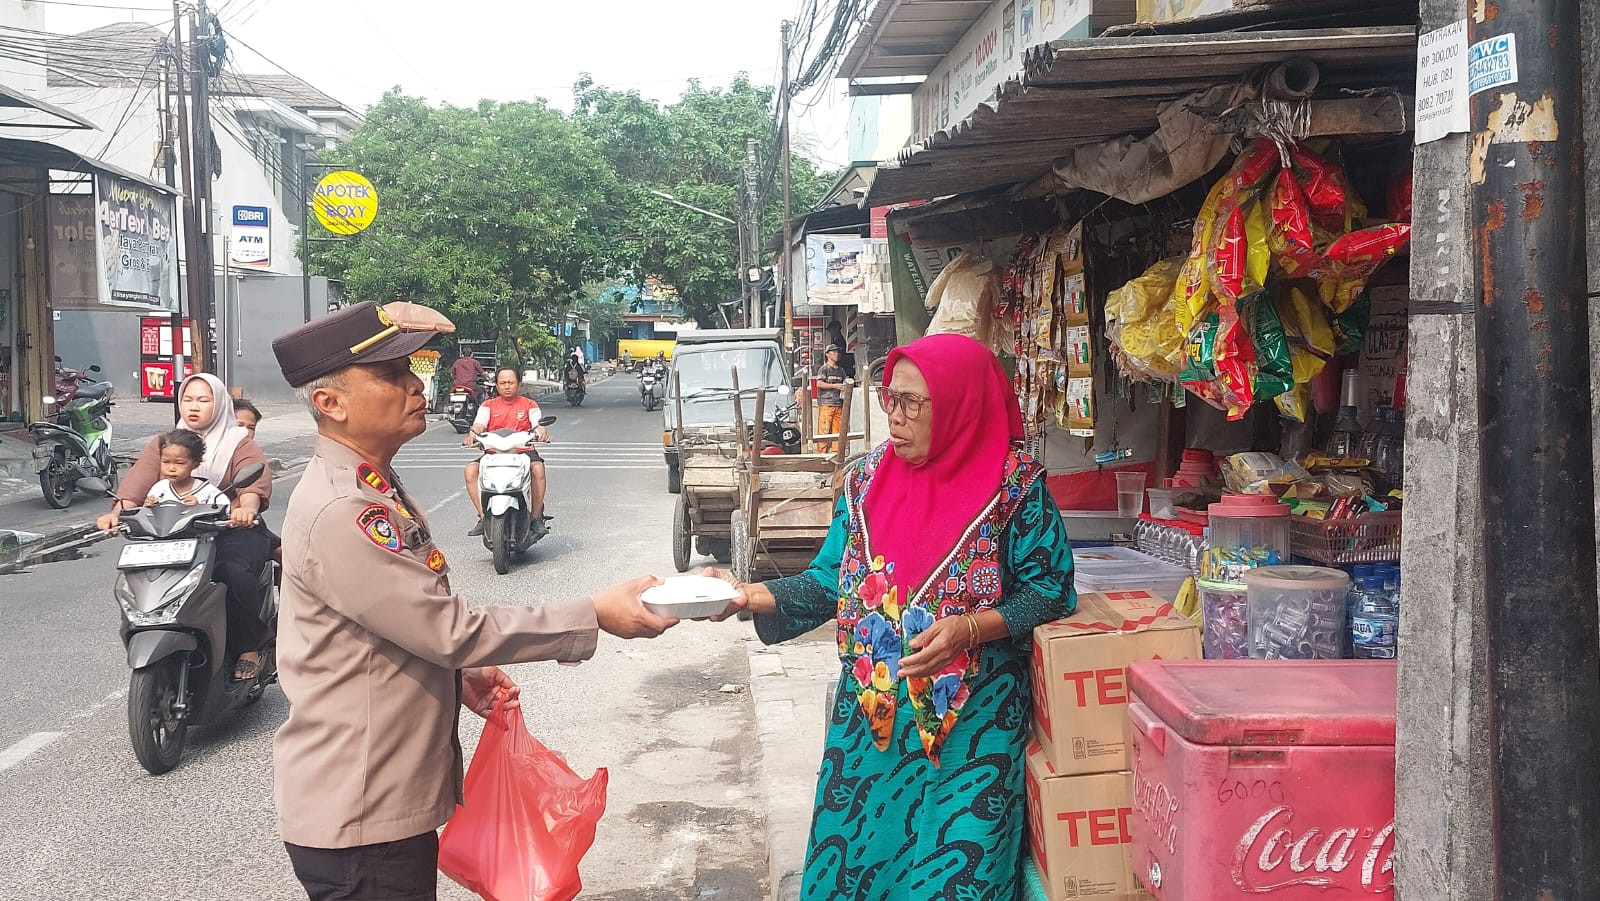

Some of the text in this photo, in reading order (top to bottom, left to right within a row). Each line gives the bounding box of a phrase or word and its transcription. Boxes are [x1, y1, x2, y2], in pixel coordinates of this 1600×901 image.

[1420, 20, 1463, 48] KONTRAKAN
[1479, 38, 1508, 59] WC
[1421, 55, 1430, 69] RP
[1440, 67, 1453, 82] 081
[318, 184, 369, 198] APOTEK
[248, 211, 264, 221] BRI
[326, 204, 366, 219] ROXY
[238, 235, 263, 244] ATM
[1353, 622, 1372, 635] QUA
[1064, 667, 1129, 707] TE
